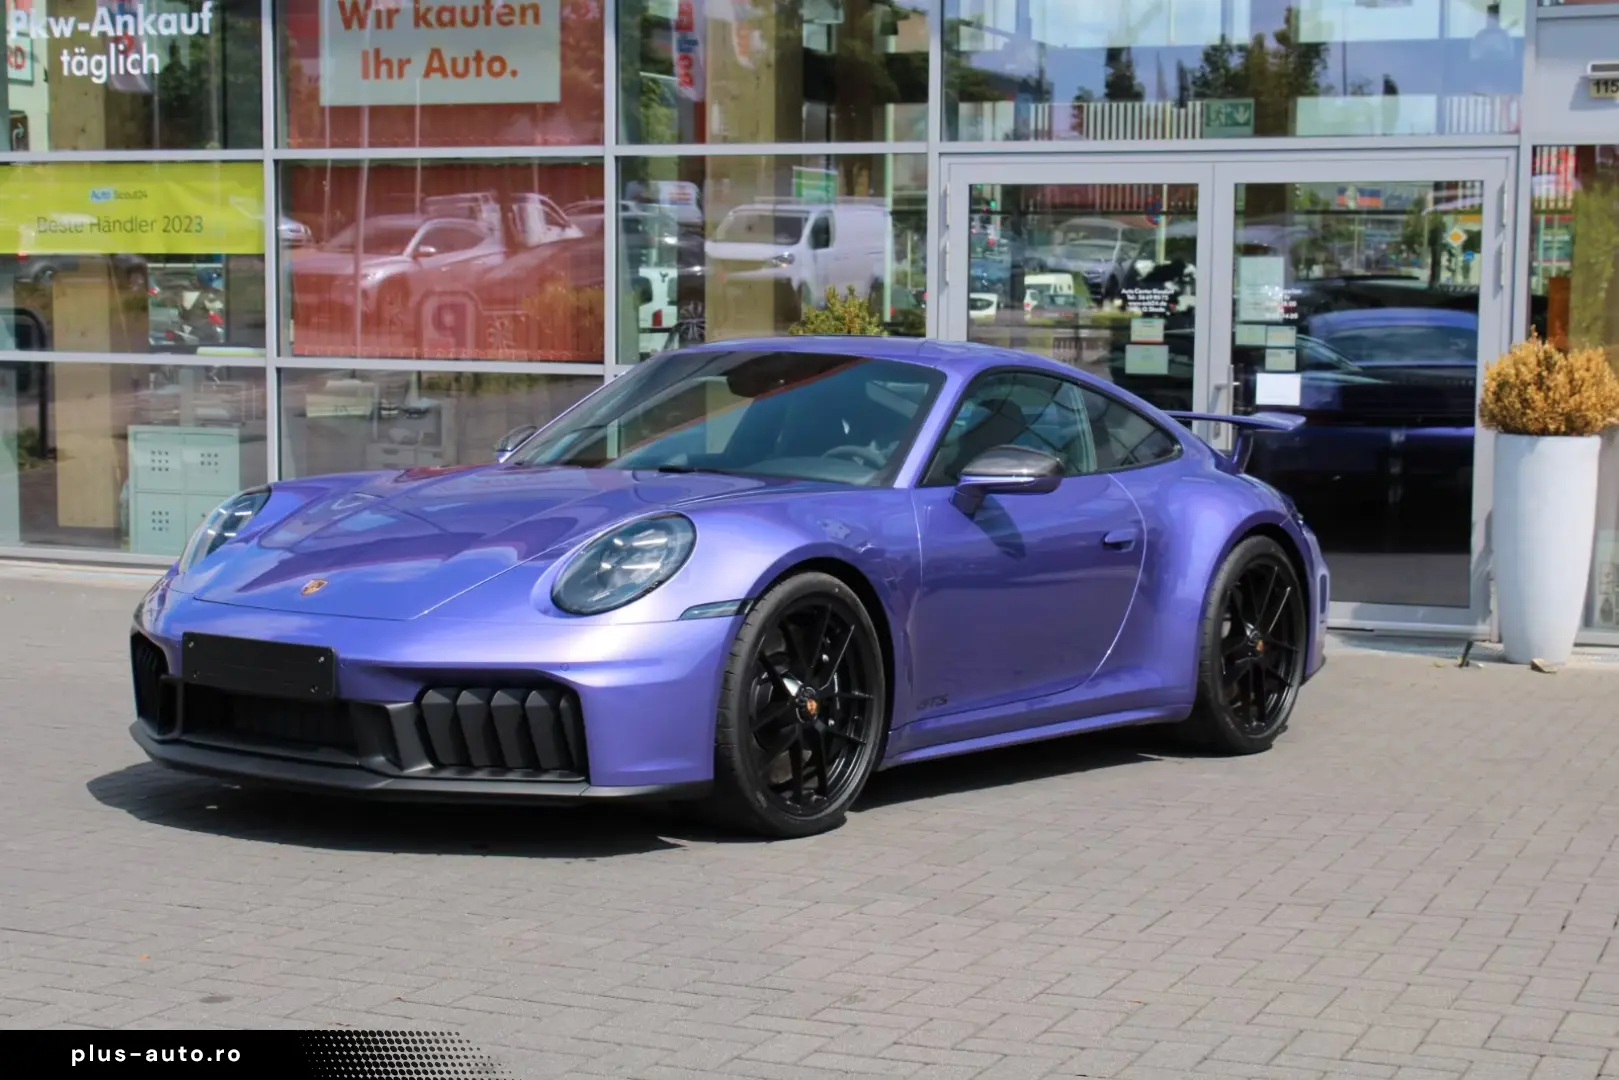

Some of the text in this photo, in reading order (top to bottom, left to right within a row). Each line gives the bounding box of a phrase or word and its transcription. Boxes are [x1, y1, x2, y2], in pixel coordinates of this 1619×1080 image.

[10, 1, 213, 39] Pkw-Ankauf
[338, 0, 540, 31] Wir kaufen
[60, 42, 160, 84] täglich
[361, 48, 518, 80] Ihr Auto.
[36, 215, 203, 234] Beste Händler 2023
